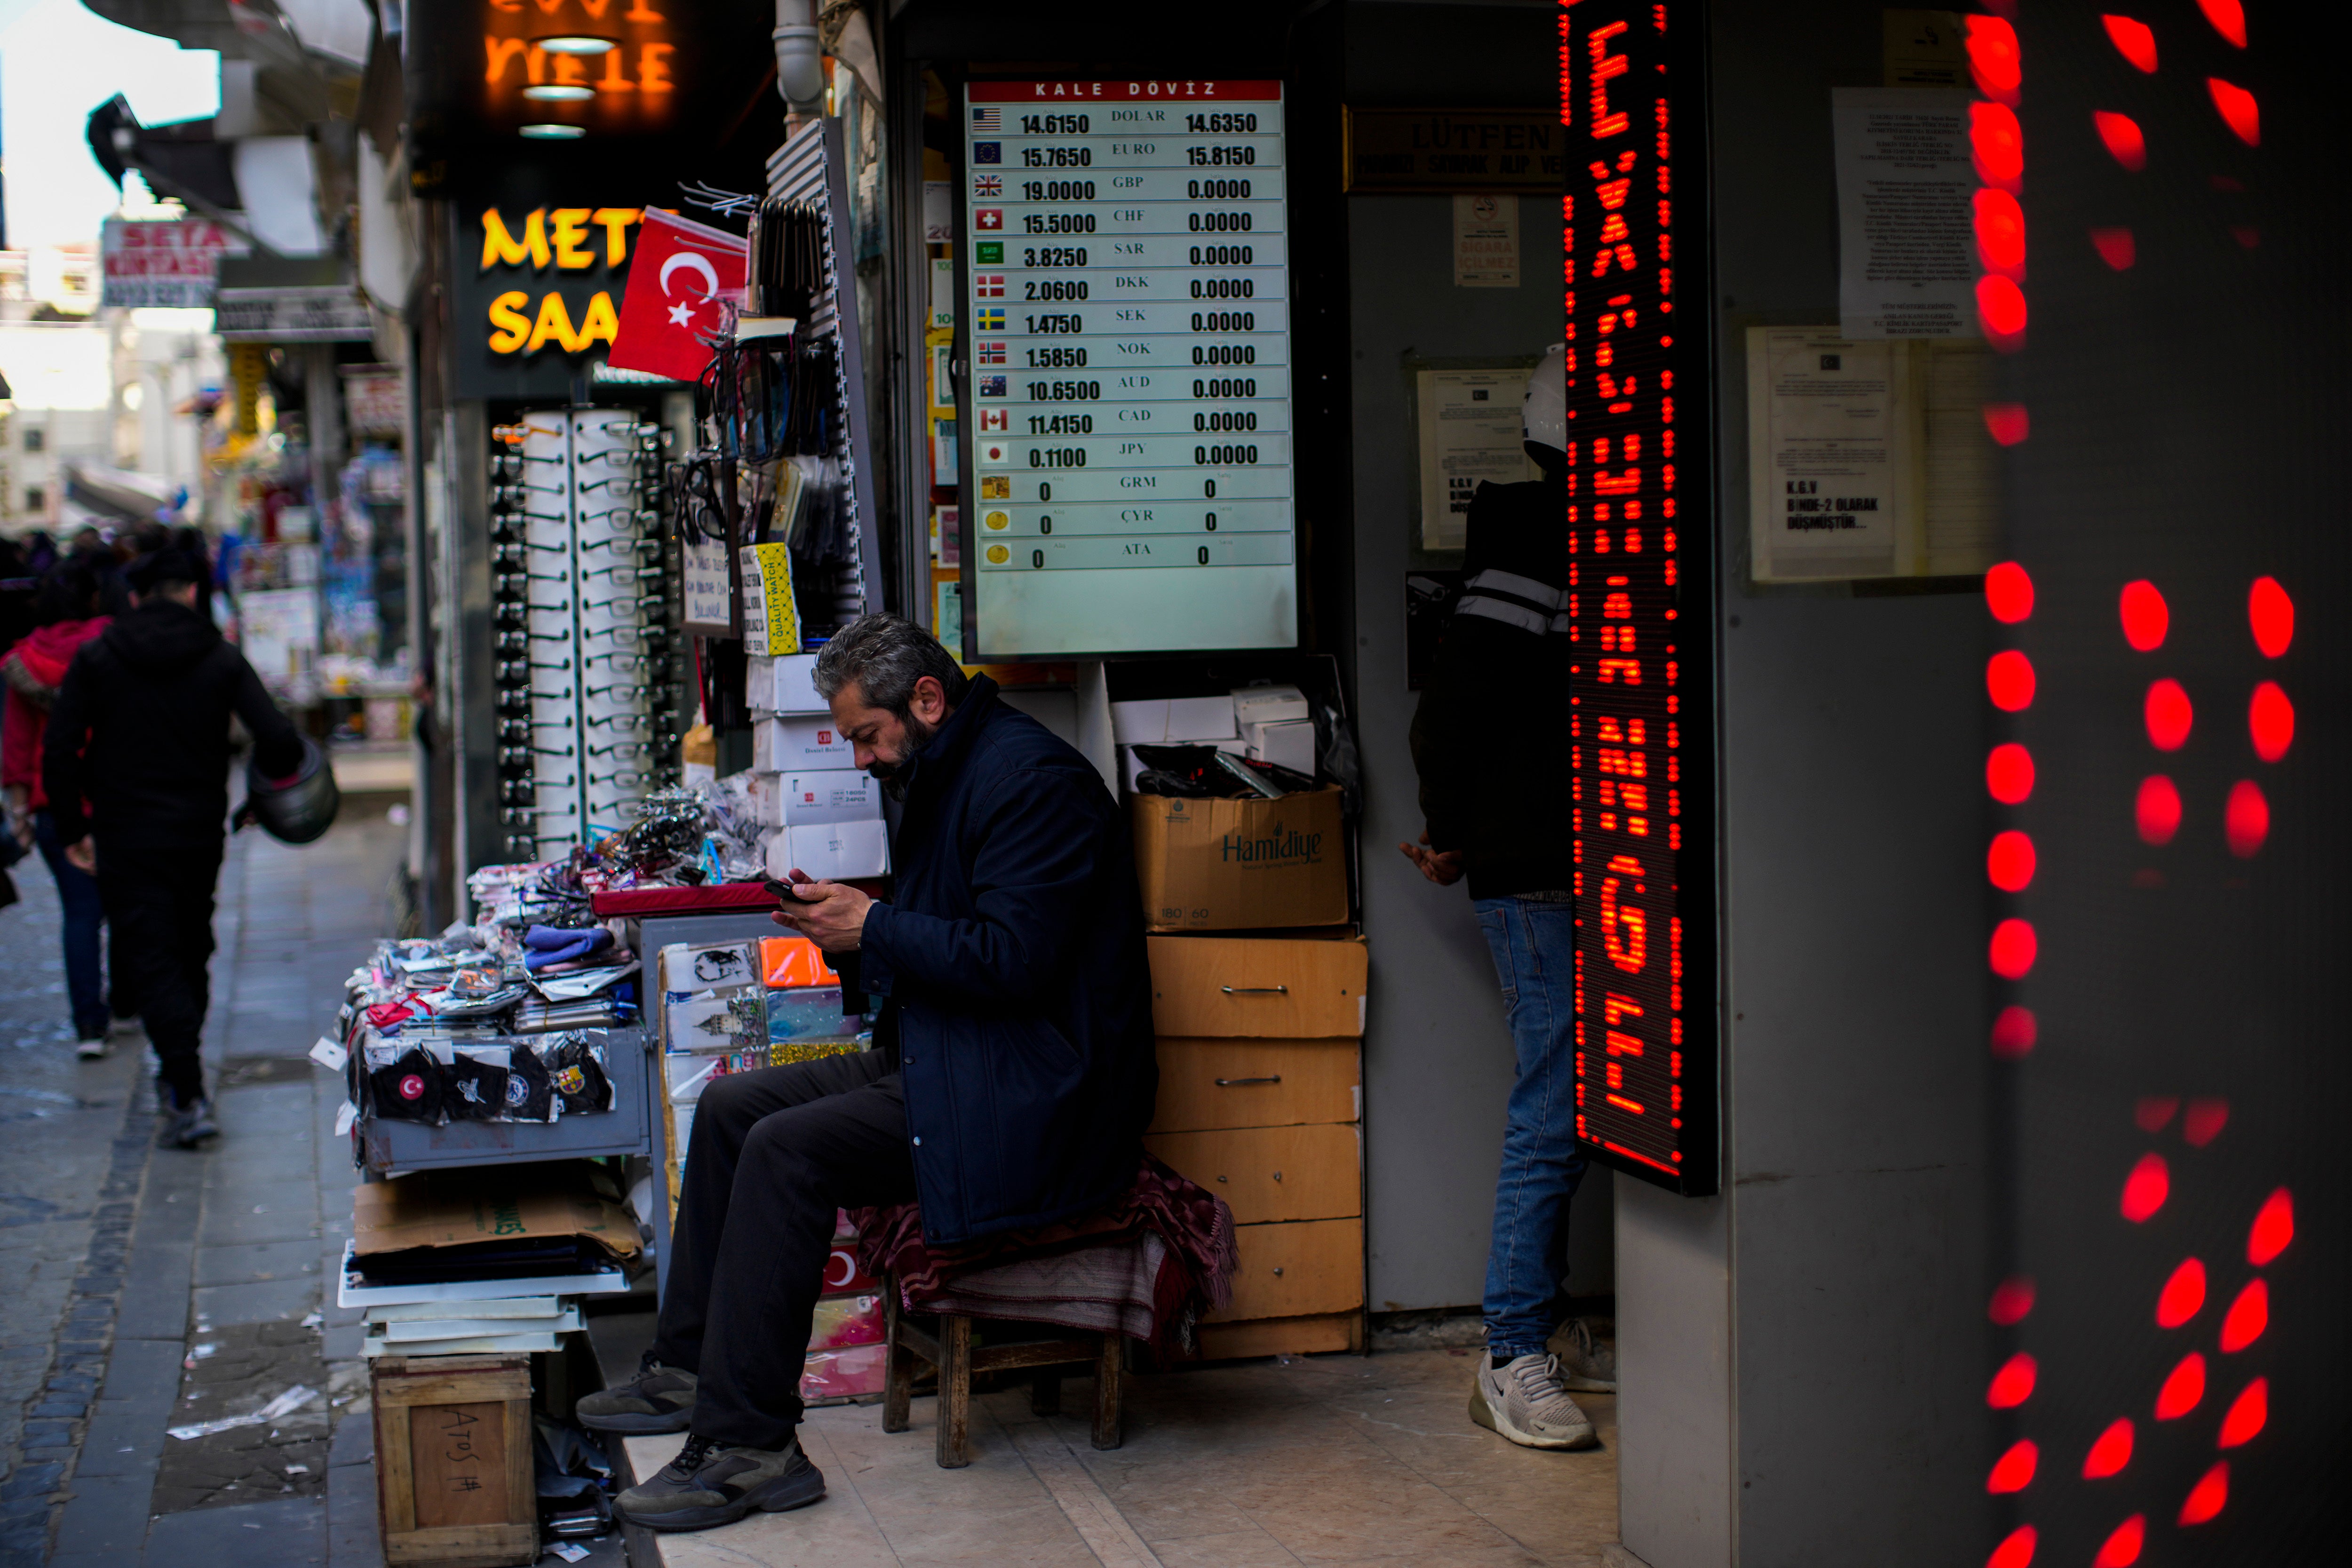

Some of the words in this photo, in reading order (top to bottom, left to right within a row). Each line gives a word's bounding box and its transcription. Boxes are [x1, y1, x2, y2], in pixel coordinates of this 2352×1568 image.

[1020, 114, 1089, 134] 14.6150
[1112, 110, 1165, 122] DOLAR
[1185, 113, 1257, 132] 14.6350
[1412, 118, 1550, 150] LÜTFEN
[1021, 147, 1091, 167] 15.7650
[1112, 143, 1155, 156] EURO
[1186, 146, 1255, 165] 15.8150
[1429, 155, 1488, 174] SAYARAK
[1500, 155, 1530, 174] ALIP
[1541, 155, 1563, 174] VE
[1022, 181, 1095, 200] 19.0000
[1112, 176, 1144, 188] GBP
[1188, 179, 1251, 199] 0.0000
[1023, 214, 1096, 233] 15.5000
[1113, 210, 1145, 221] CHF
[1189, 212, 1251, 231] 0.0000
[480, 207, 679, 270] MET
[1461, 240, 1512, 253] SİGARA
[1025, 247, 1087, 267] 3.8250
[1114, 243, 1144, 254] SAR
[1190, 246, 1252, 265] 0.0000
[1459, 256, 1515, 270] İÇİLMEZ
[1025, 281, 1088, 300] 2.0600
[1116, 277, 1149, 287] DKK
[1191, 279, 1253, 298] 0.0000
[487, 290, 618, 357] SAA
[937, 314, 954, 324] 10
[1025, 314, 1081, 334] 1.4750
[1116, 310, 1145, 320] SEK
[1192, 312, 1254, 331] 0.0000
[1026, 348, 1087, 367] 1.5850
[1118, 343, 1151, 354] NOK
[1192, 345, 1255, 365] 0.0000
[1027, 381, 1100, 400] 10.6500
[1118, 376, 1150, 387] AUD
[1193, 378, 1255, 398] 0.0000
[1028, 414, 1092, 434] 11.4150
[1119, 410, 1151, 421] CAD
[1194, 412, 1256, 431] 0.0000
[1030, 448, 1086, 468] 0.1100
[1120, 443, 1146, 454] JPY
[1195, 445, 1257, 464] 0.0000
[1040, 482, 1050, 501] 0
[1120, 477, 1155, 487] GRM
[1205, 479, 1216, 498] 0
[1787, 481, 1818, 494] K.G.V
[1836, 498, 1878, 511] OLARAK
[1041, 516, 1051, 534] 0
[1121, 510, 1153, 523] ÇYR
[1206, 512, 1216, 531] 0
[1033, 549, 1043, 569] 0
[1123, 543, 1151, 554] ATA
[1198, 546, 1208, 565] 0
[768, 562, 778, 595] WATCH
[773, 597, 784, 637] QUALITY
[1221, 829, 1322, 864] Hamidiye
[1162, 908, 1182, 918] 180
[1192, 908, 1209, 918] 60
